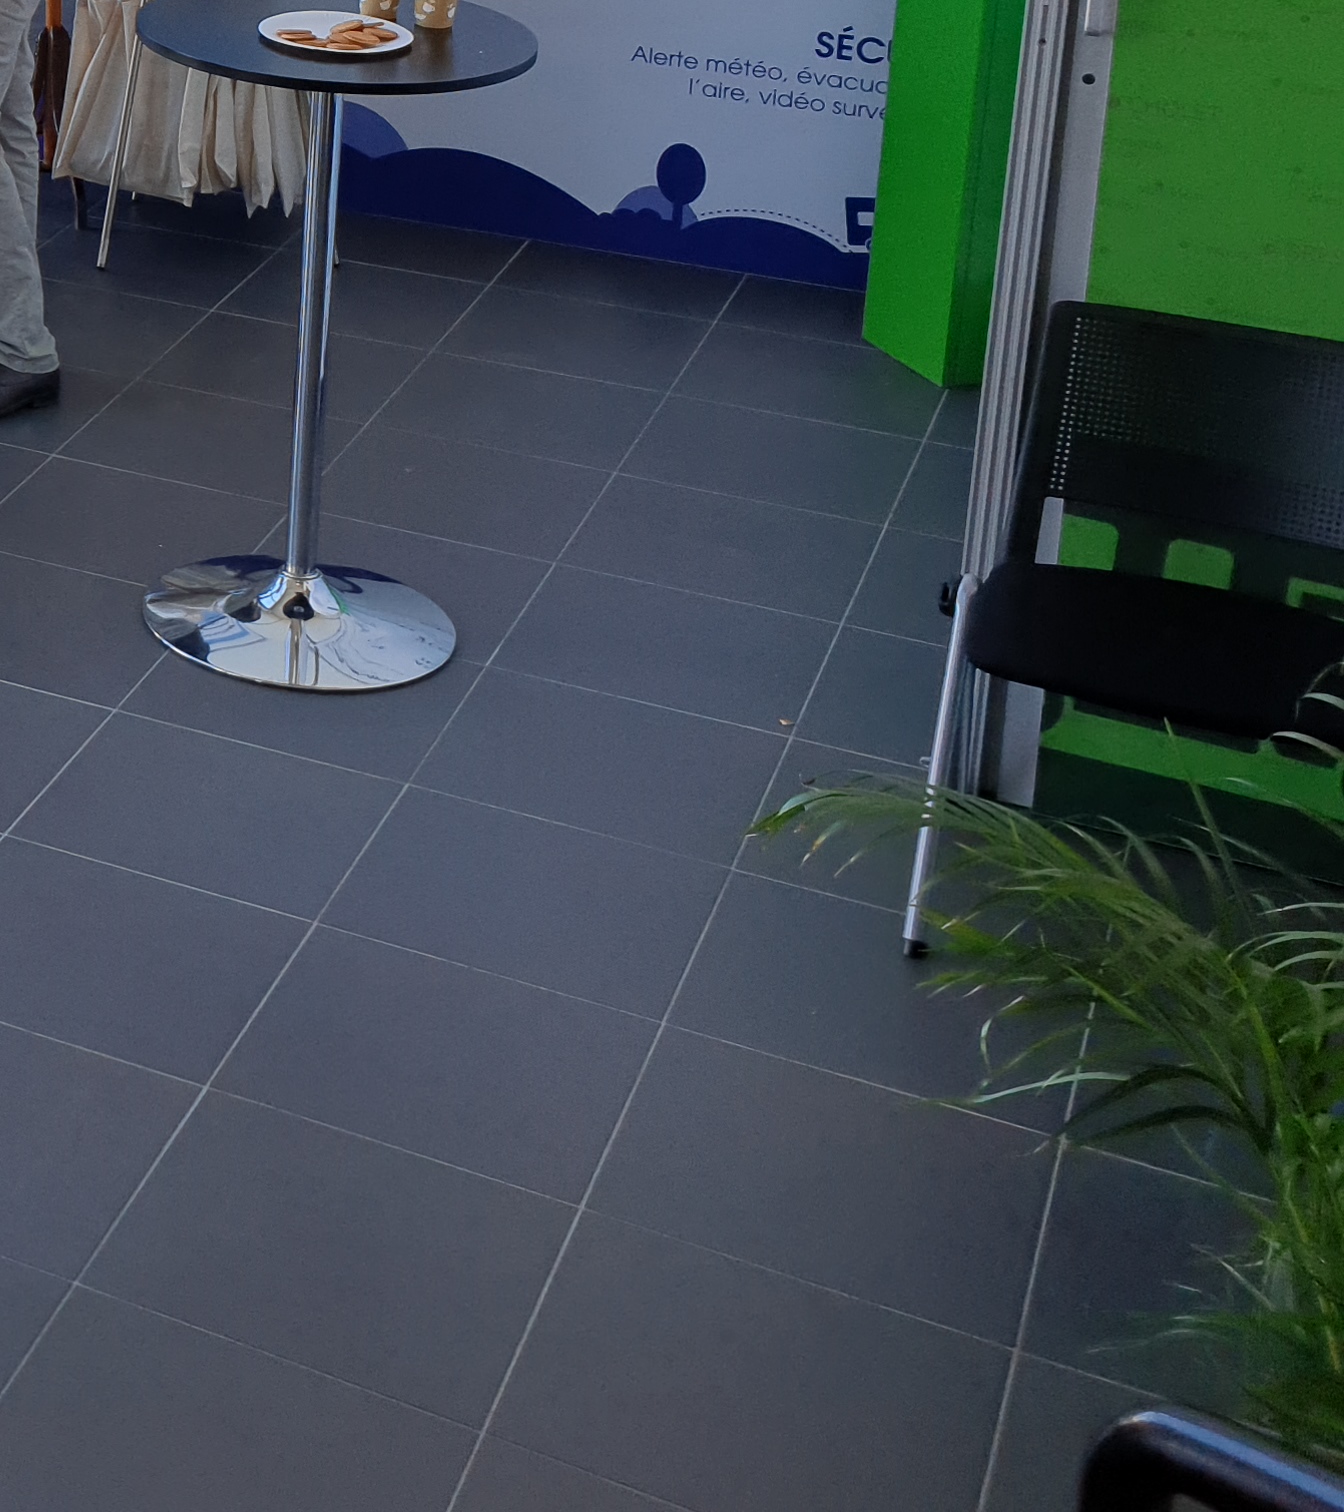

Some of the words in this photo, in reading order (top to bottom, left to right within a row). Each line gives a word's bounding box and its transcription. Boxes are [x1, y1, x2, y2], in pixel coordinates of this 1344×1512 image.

[630, 45, 699, 69] Alerte
[706, 57, 788, 83] météo,
[814, 25, 892, 65] SÉC
[758, 89, 826, 112] vidéo
